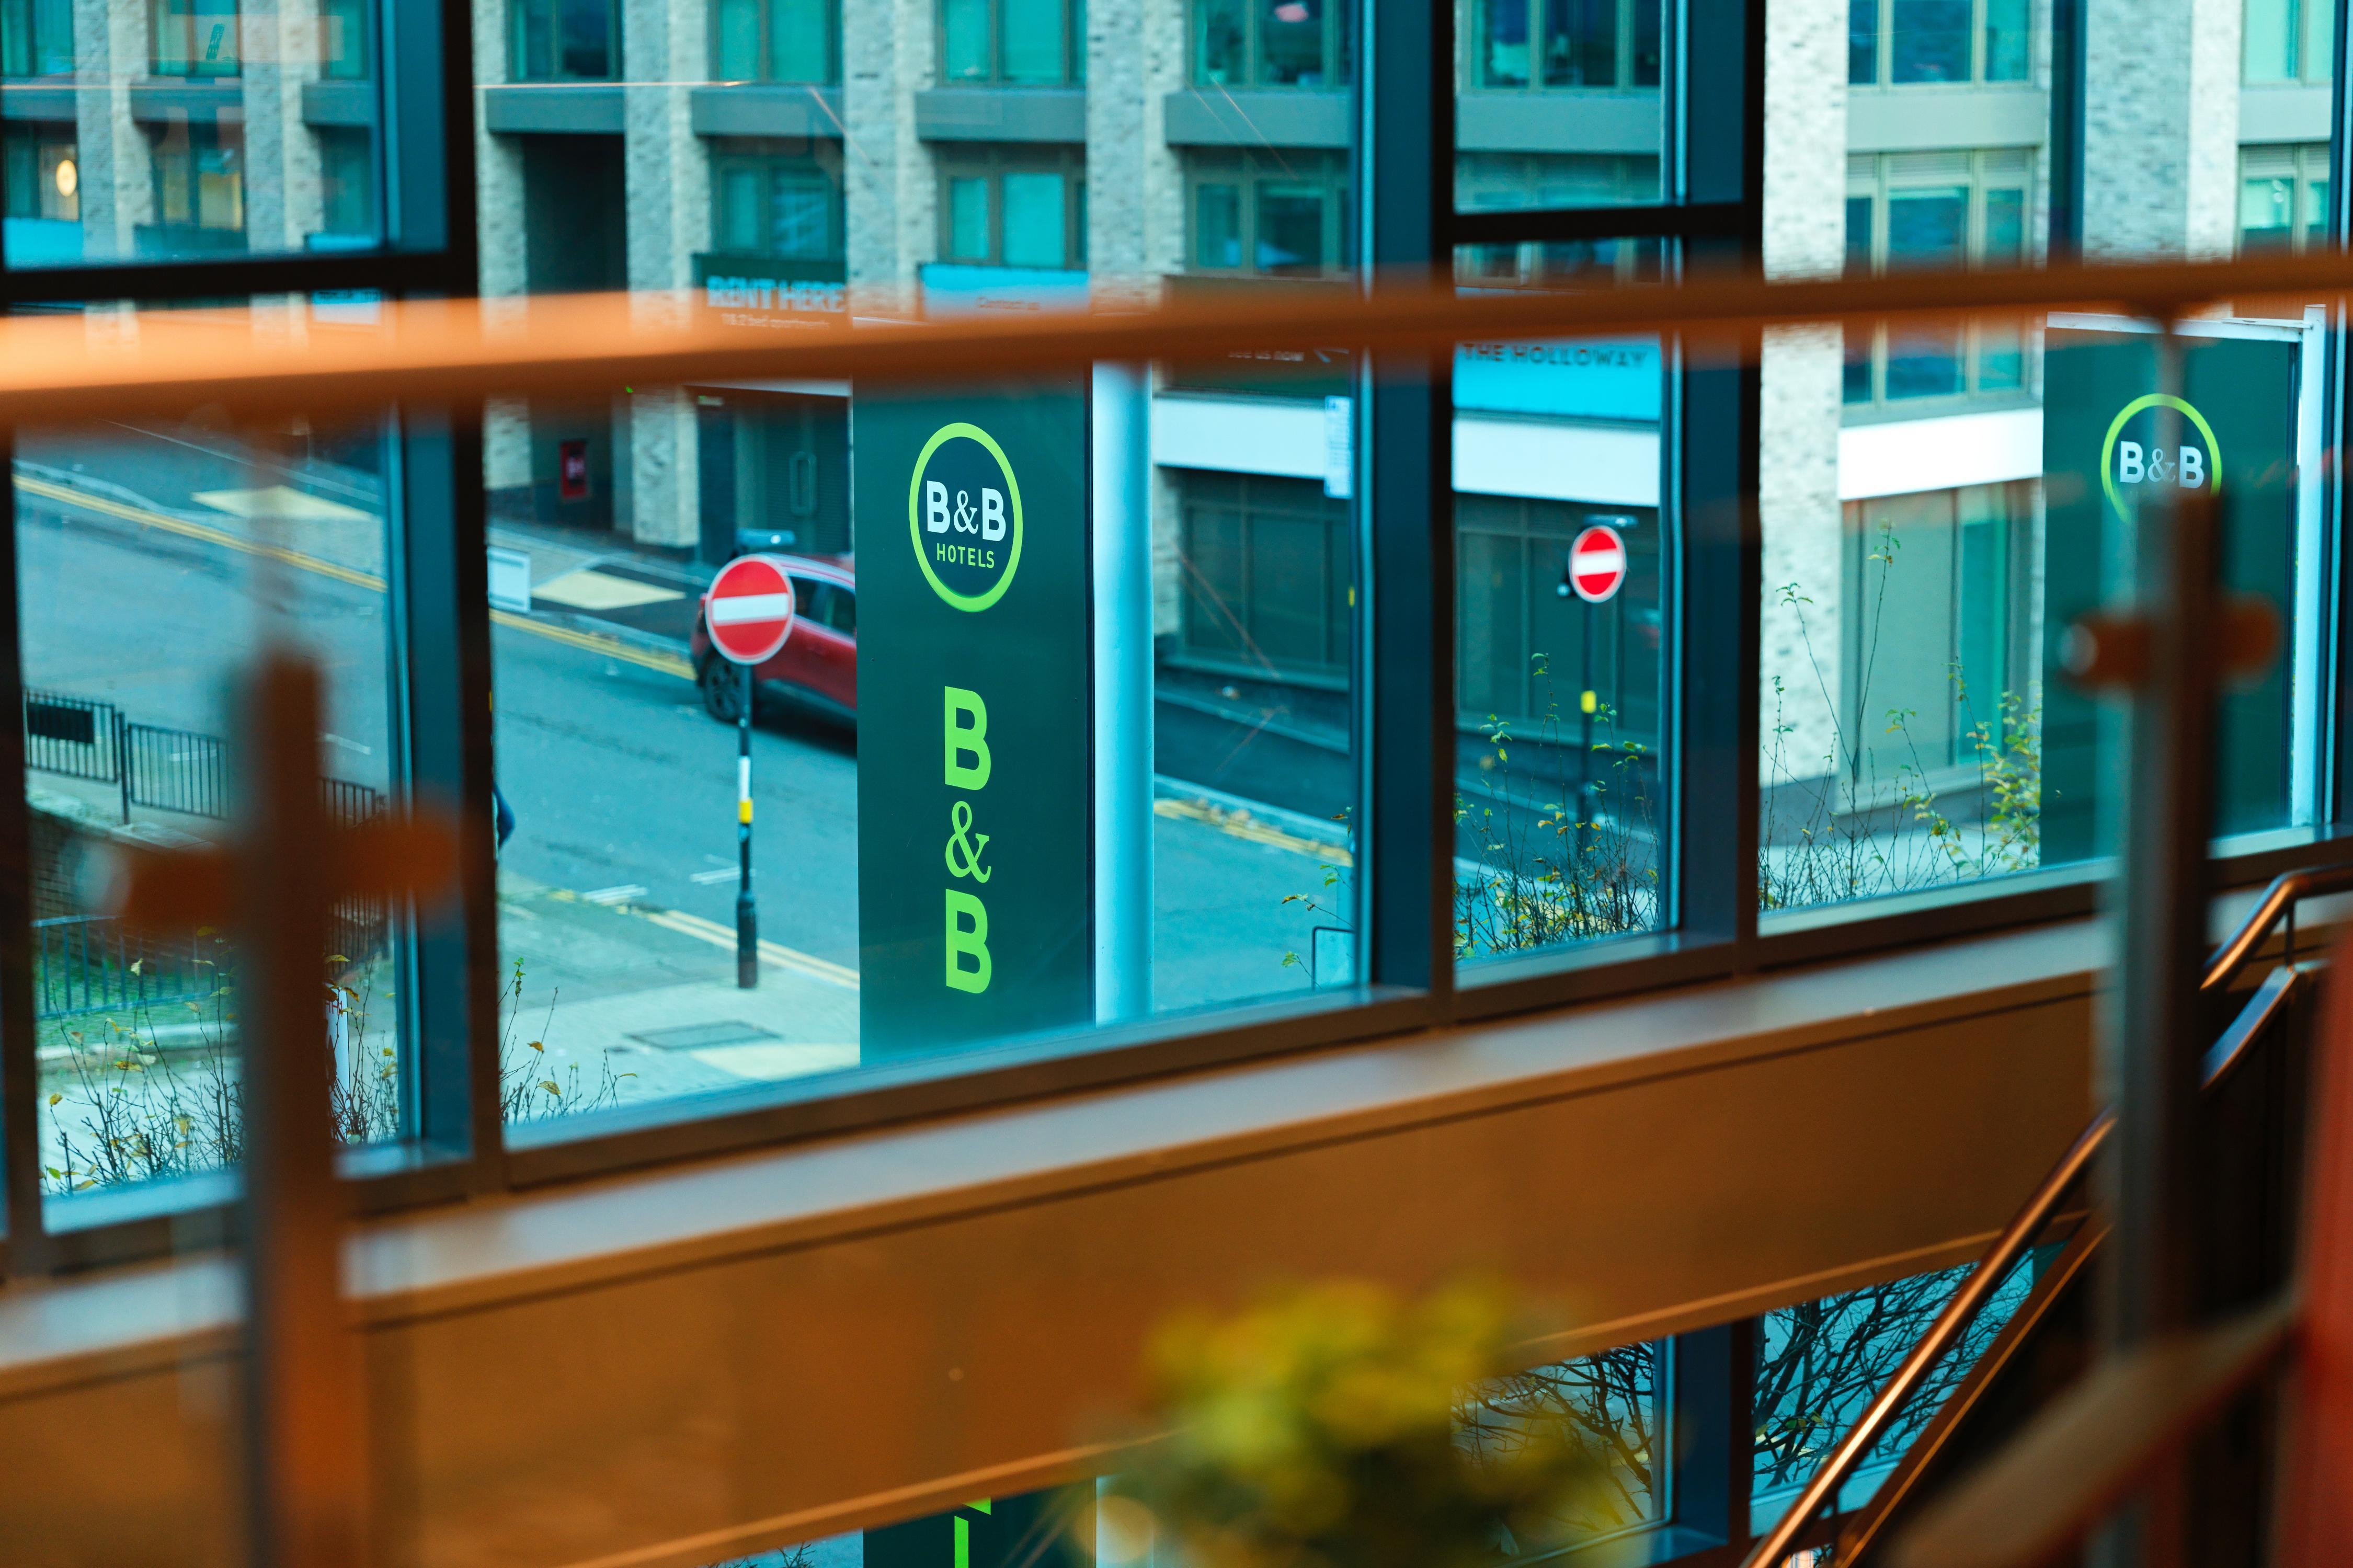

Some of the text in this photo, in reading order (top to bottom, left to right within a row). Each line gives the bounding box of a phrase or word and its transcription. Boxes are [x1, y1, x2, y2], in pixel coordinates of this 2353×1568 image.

[706, 276, 846, 313] RENT HERE
[1464, 342, 1648, 368] THE HOLLOWAY
[2119, 440, 2204, 489] B&B
[927, 480, 1006, 542] B&B
[936, 543, 995, 569] HOTELS
[944, 685, 992, 994] B&B
